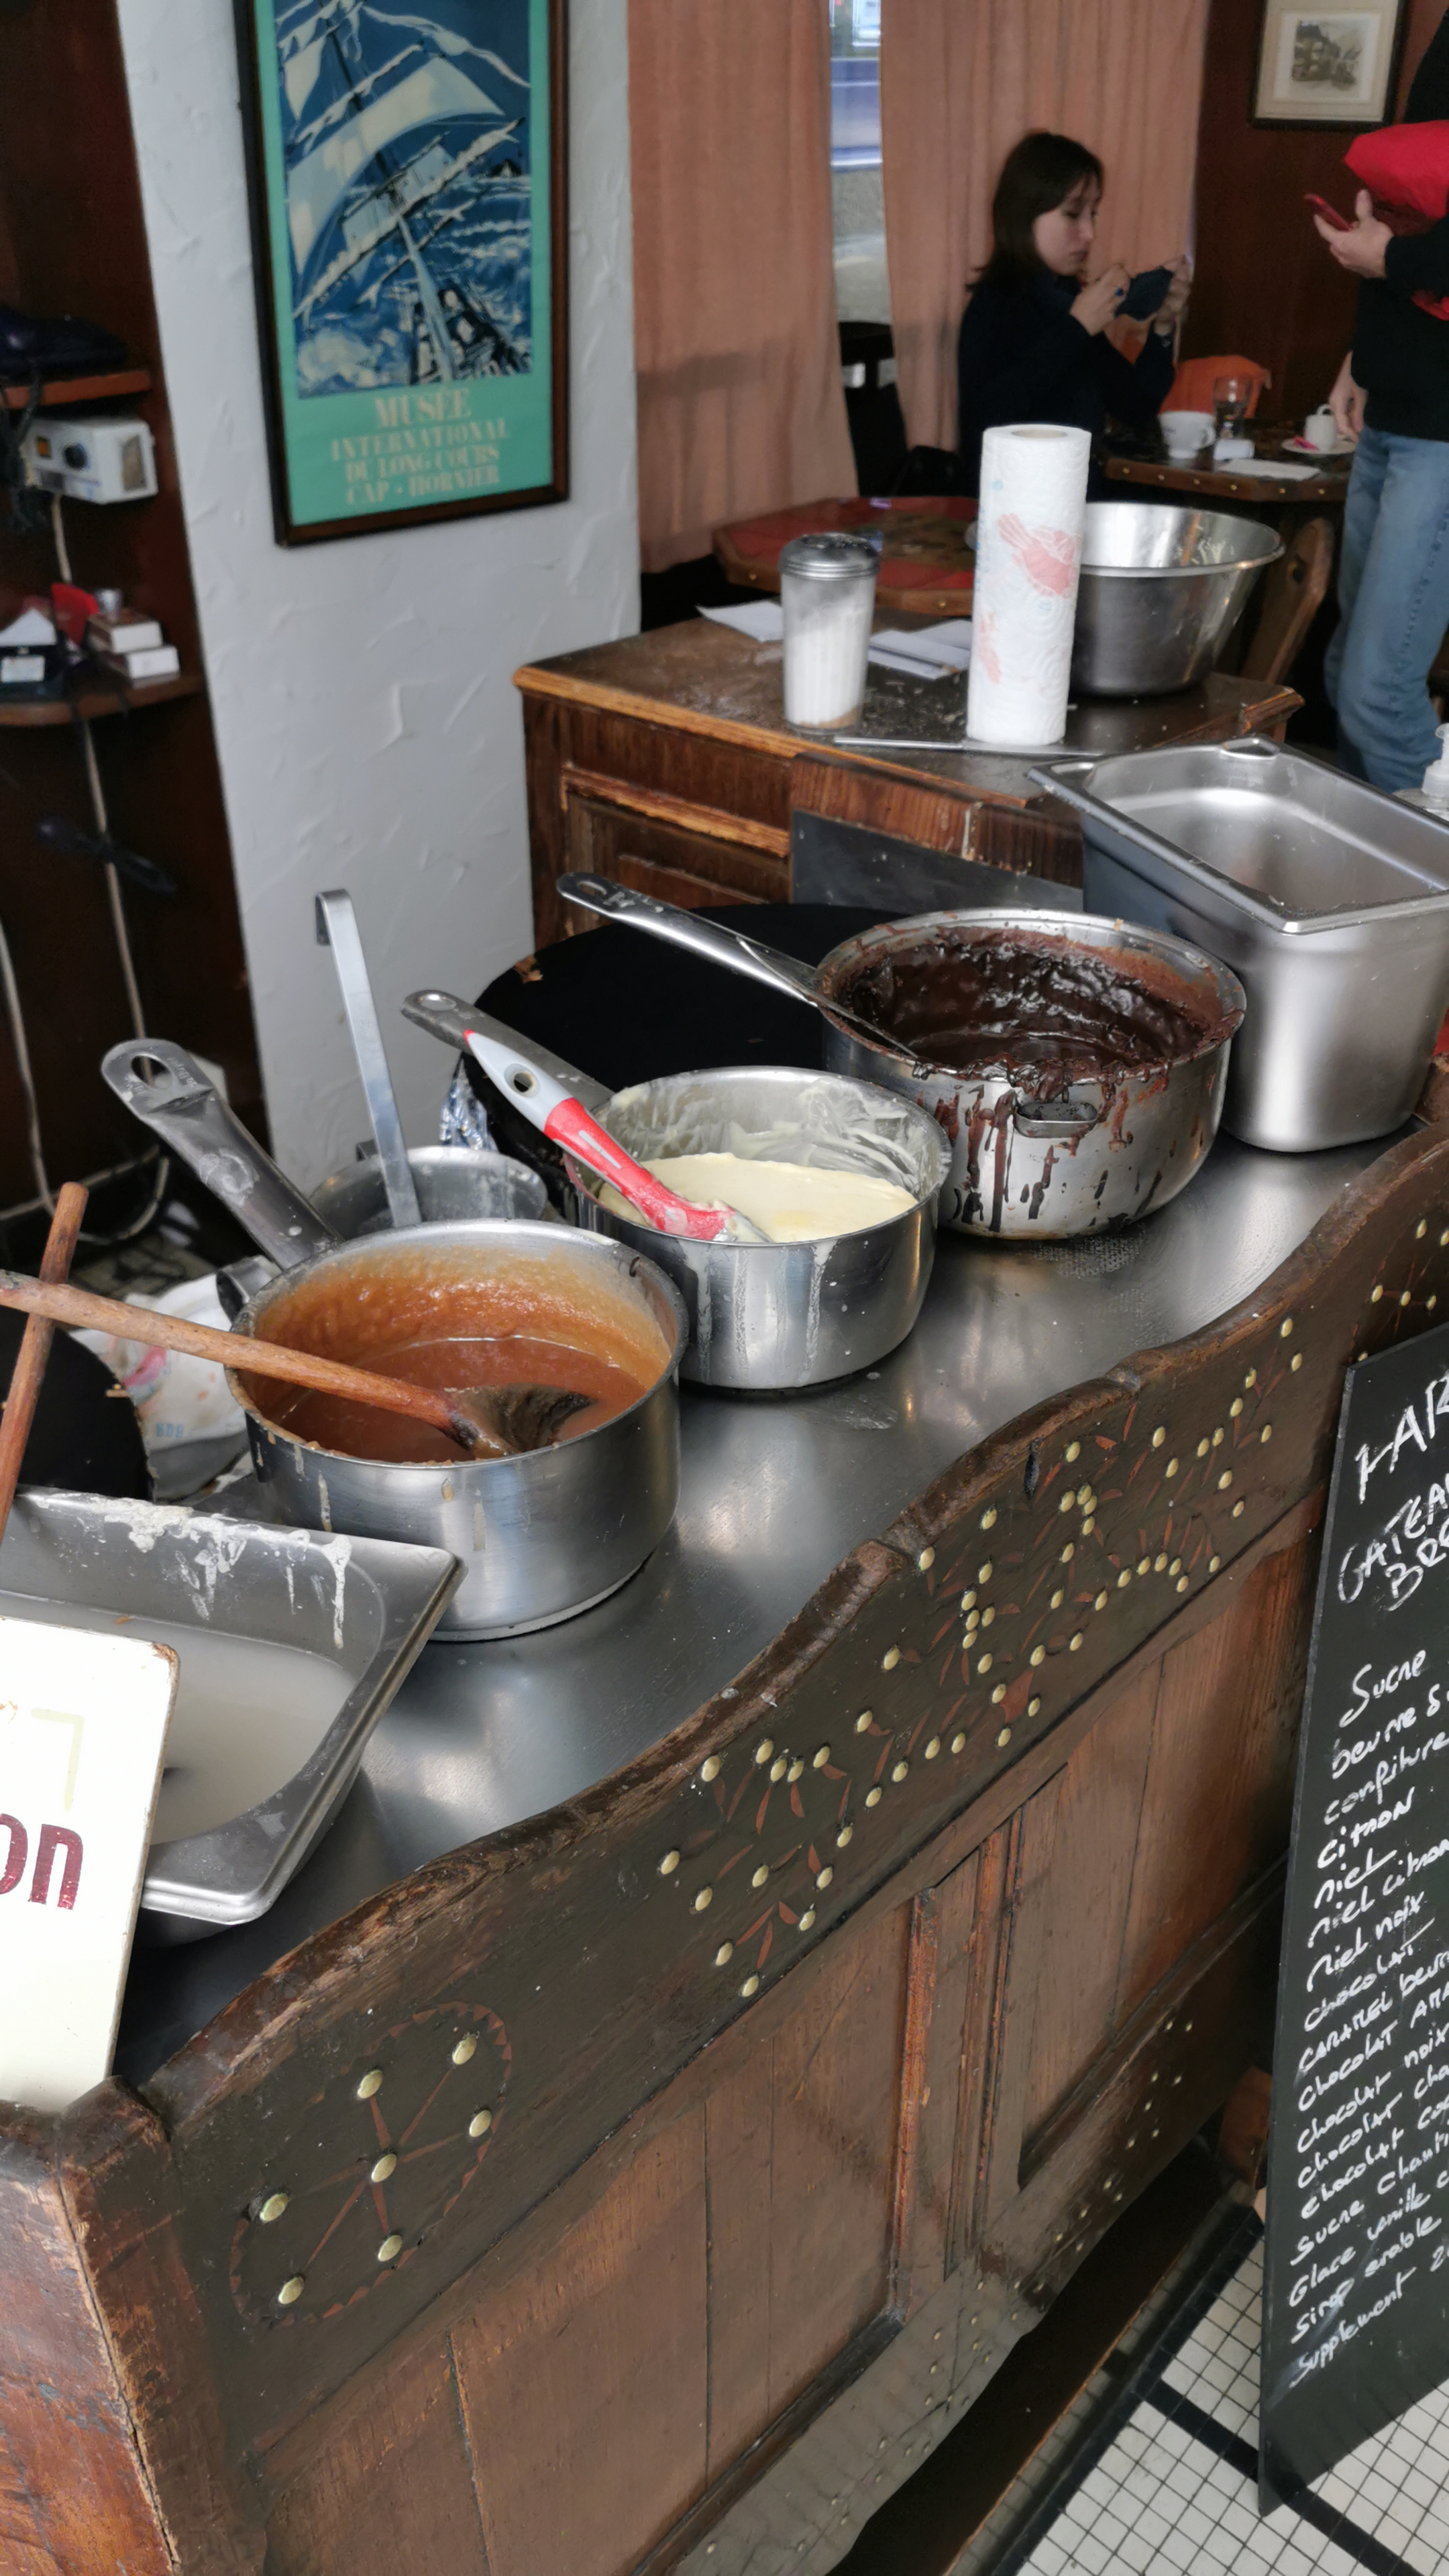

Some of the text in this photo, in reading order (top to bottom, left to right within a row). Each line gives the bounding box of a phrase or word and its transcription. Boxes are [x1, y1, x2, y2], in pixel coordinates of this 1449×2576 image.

[331, 417, 510, 462] INTERNATIONAL
[345, 480, 390, 505] CAP
[1338, 1473, 1449, 1604] GATEA
